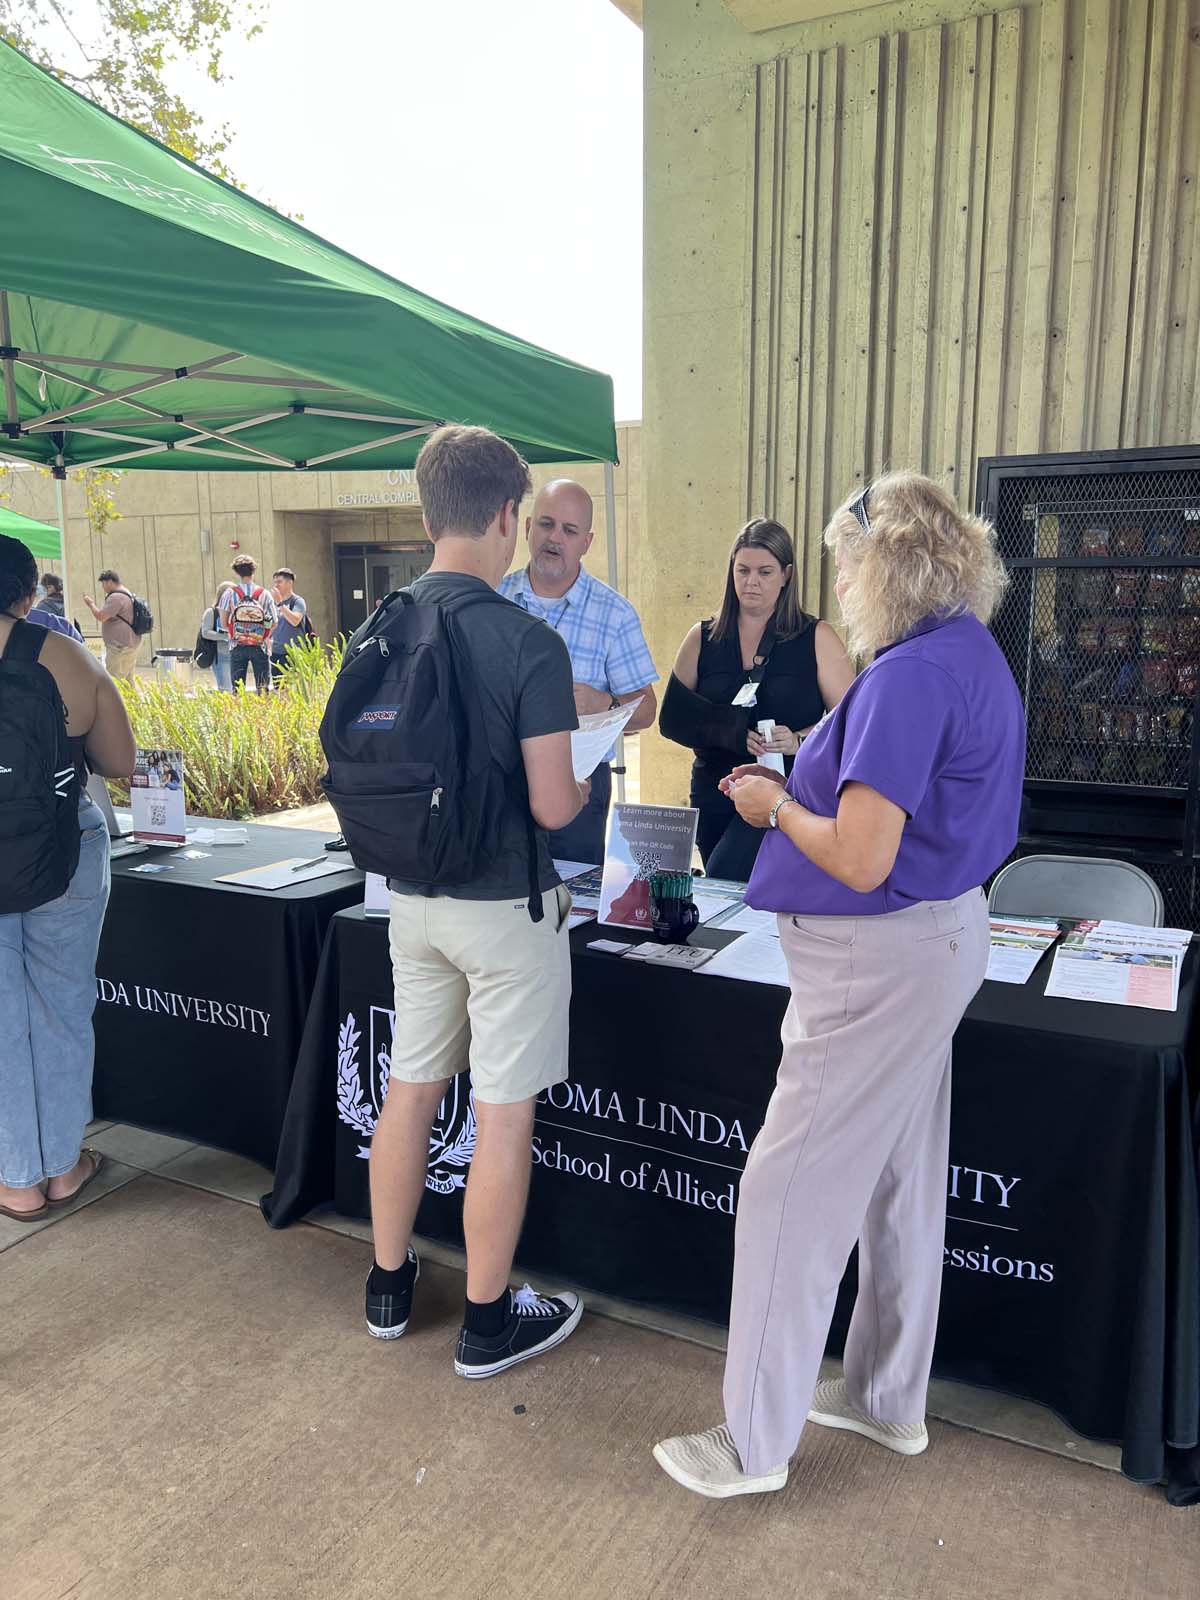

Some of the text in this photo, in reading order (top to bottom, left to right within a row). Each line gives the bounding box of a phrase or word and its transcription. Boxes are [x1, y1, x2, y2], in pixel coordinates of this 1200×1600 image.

[336, 491, 420, 505] CENTRAL COMPL
[623, 806, 686, 819] Learn more about
[634, 820, 653, 829] Linda
[655, 823, 691, 834] University
[96, 977, 271, 1037] DA UNIVERSITY
[636, 1096, 749, 1152] LINDA
[948, 1165, 1022, 1208] ITY
[531, 1136, 612, 1184] School
[619, 1161, 651, 1191] of
[652, 1168, 735, 1215] Allied
[427, 1178, 454, 1193] WHOLE
